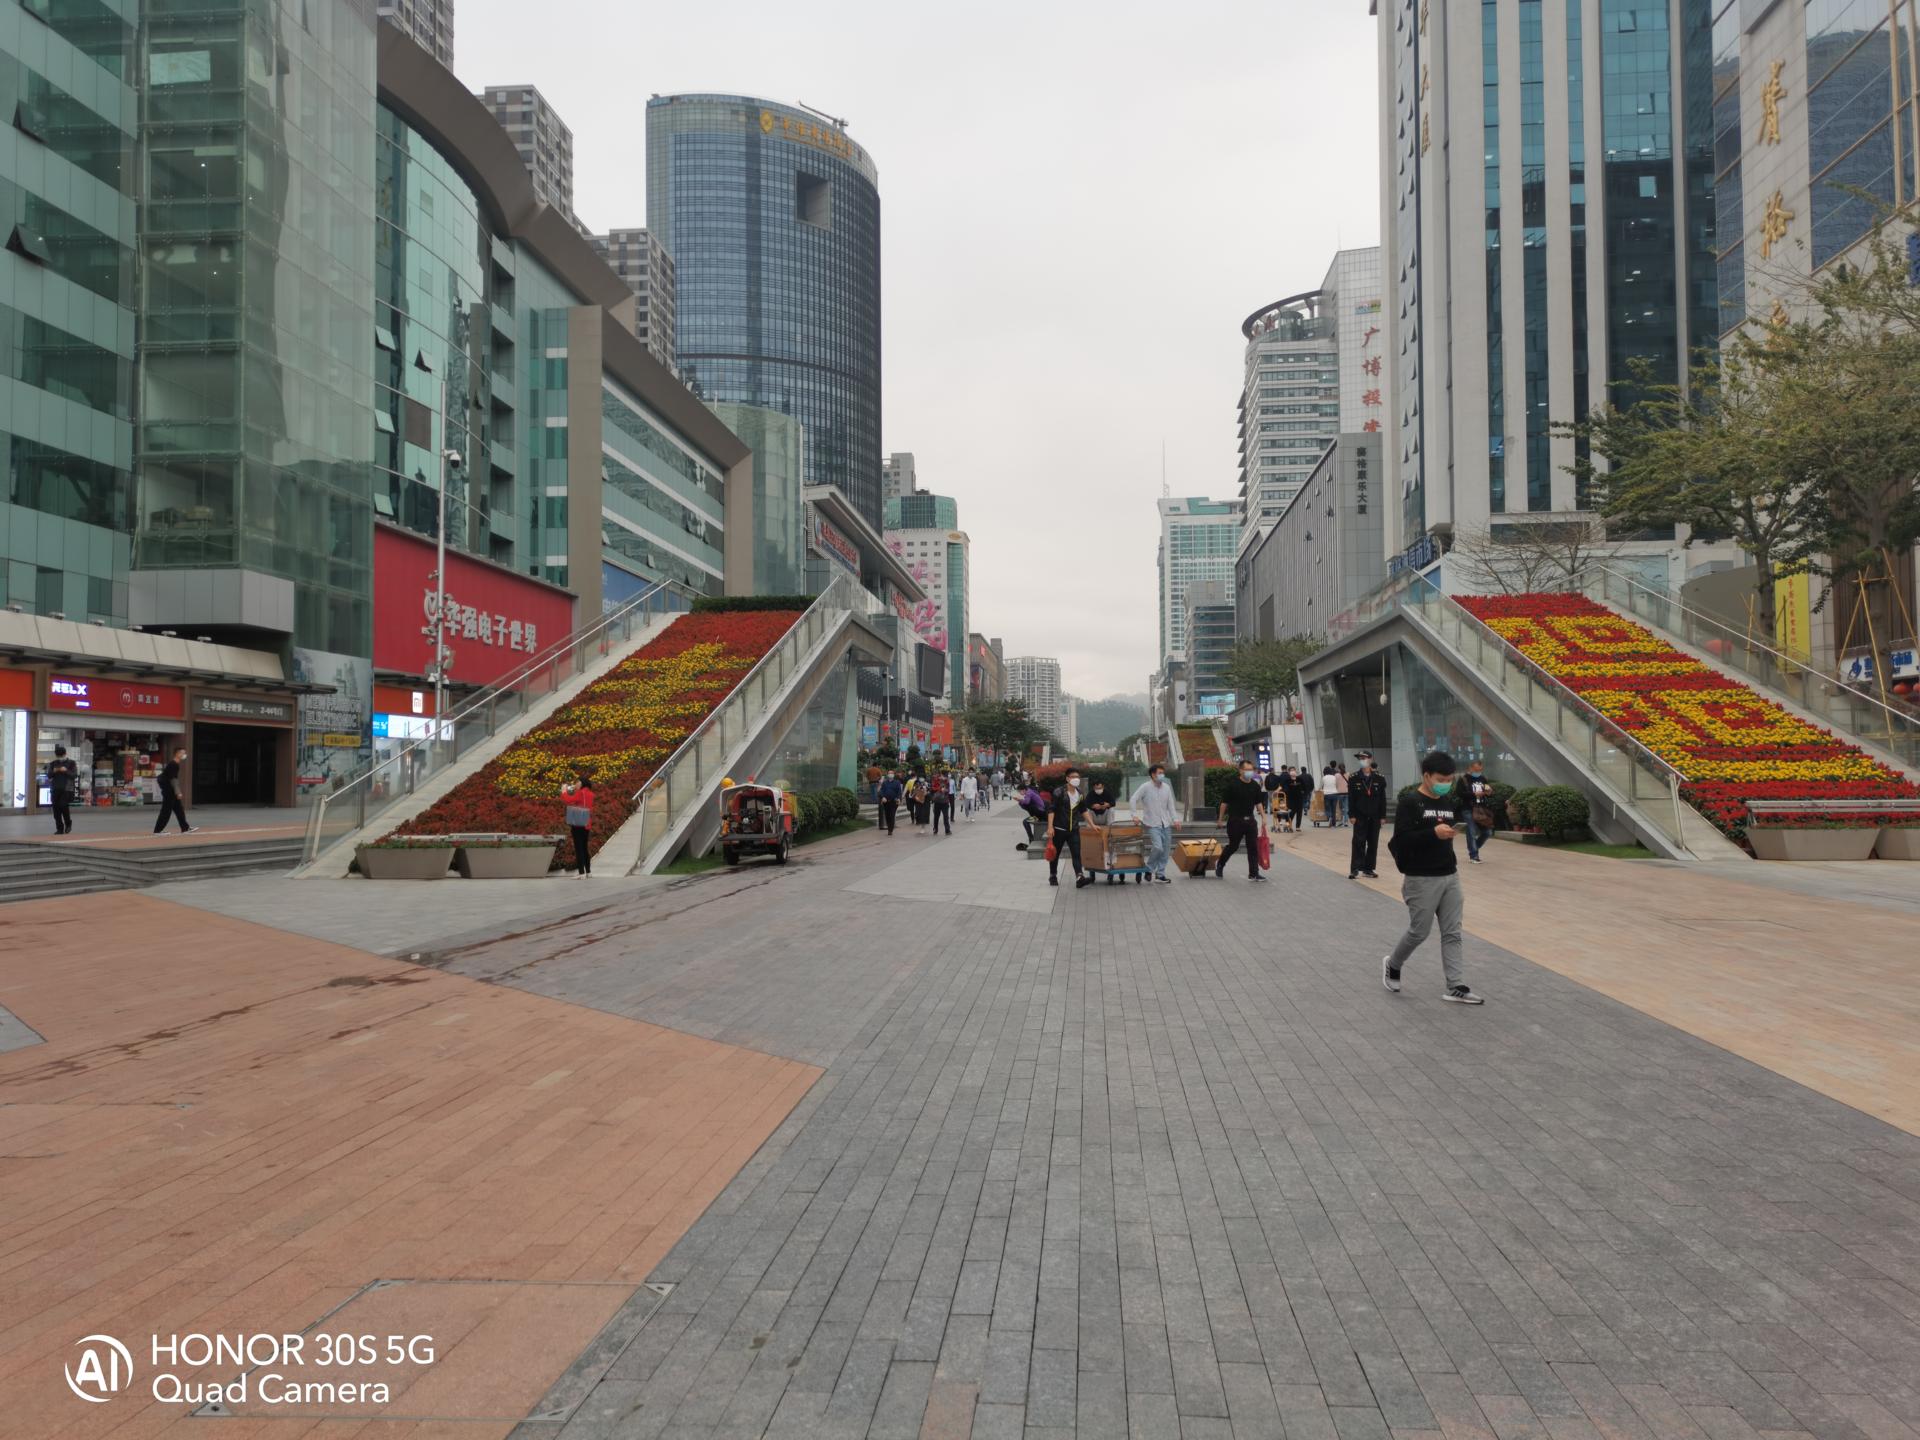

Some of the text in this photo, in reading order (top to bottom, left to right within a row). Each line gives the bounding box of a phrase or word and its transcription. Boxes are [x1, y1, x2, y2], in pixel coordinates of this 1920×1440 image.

[445, 597, 538, 654] 华强电子世界
[51, 682, 87, 696] RELX
